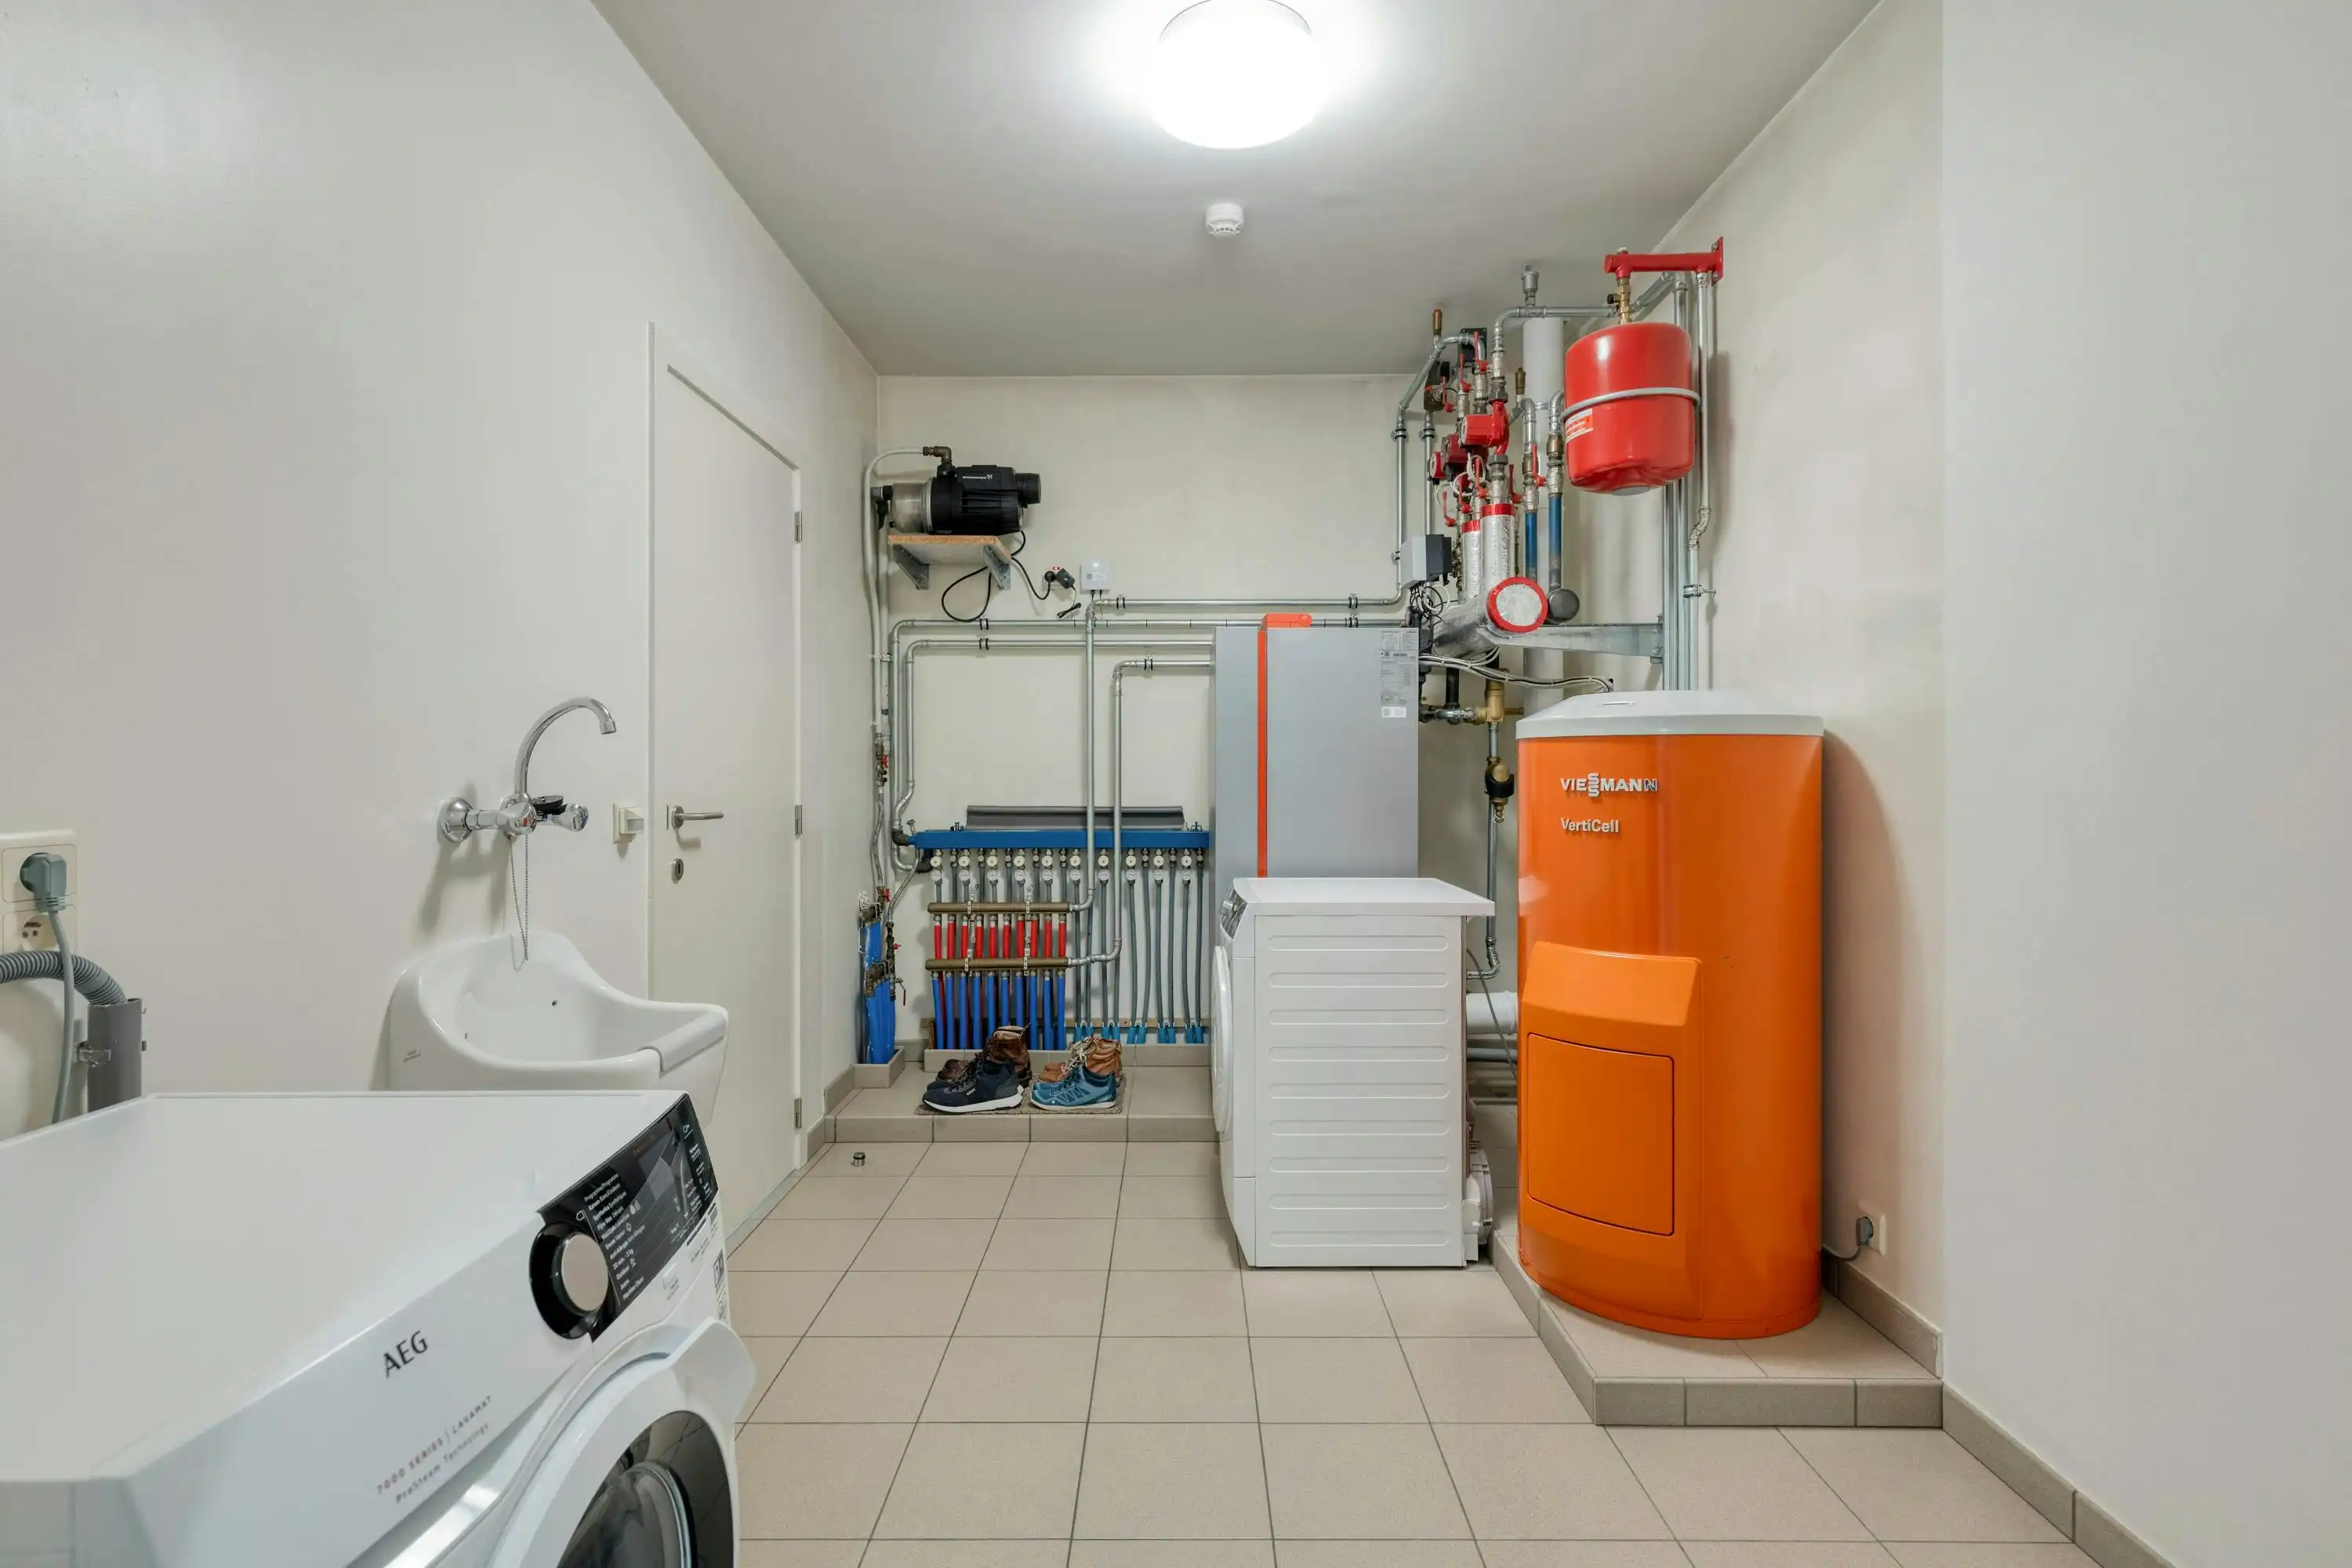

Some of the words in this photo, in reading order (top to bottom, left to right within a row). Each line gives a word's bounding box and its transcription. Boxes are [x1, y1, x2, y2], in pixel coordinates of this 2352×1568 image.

[1560, 772, 1659, 797] VIESSMANN
[1560, 817, 1620, 833] VertiCell
[383, 1330, 428, 1379] AEG
[376, 1468, 405, 1495] 7000
[408, 1437, 443, 1469] SERIES
[452, 1395, 491, 1434] LAVAMAT
[396, 1464, 441, 1503] ProSteam
